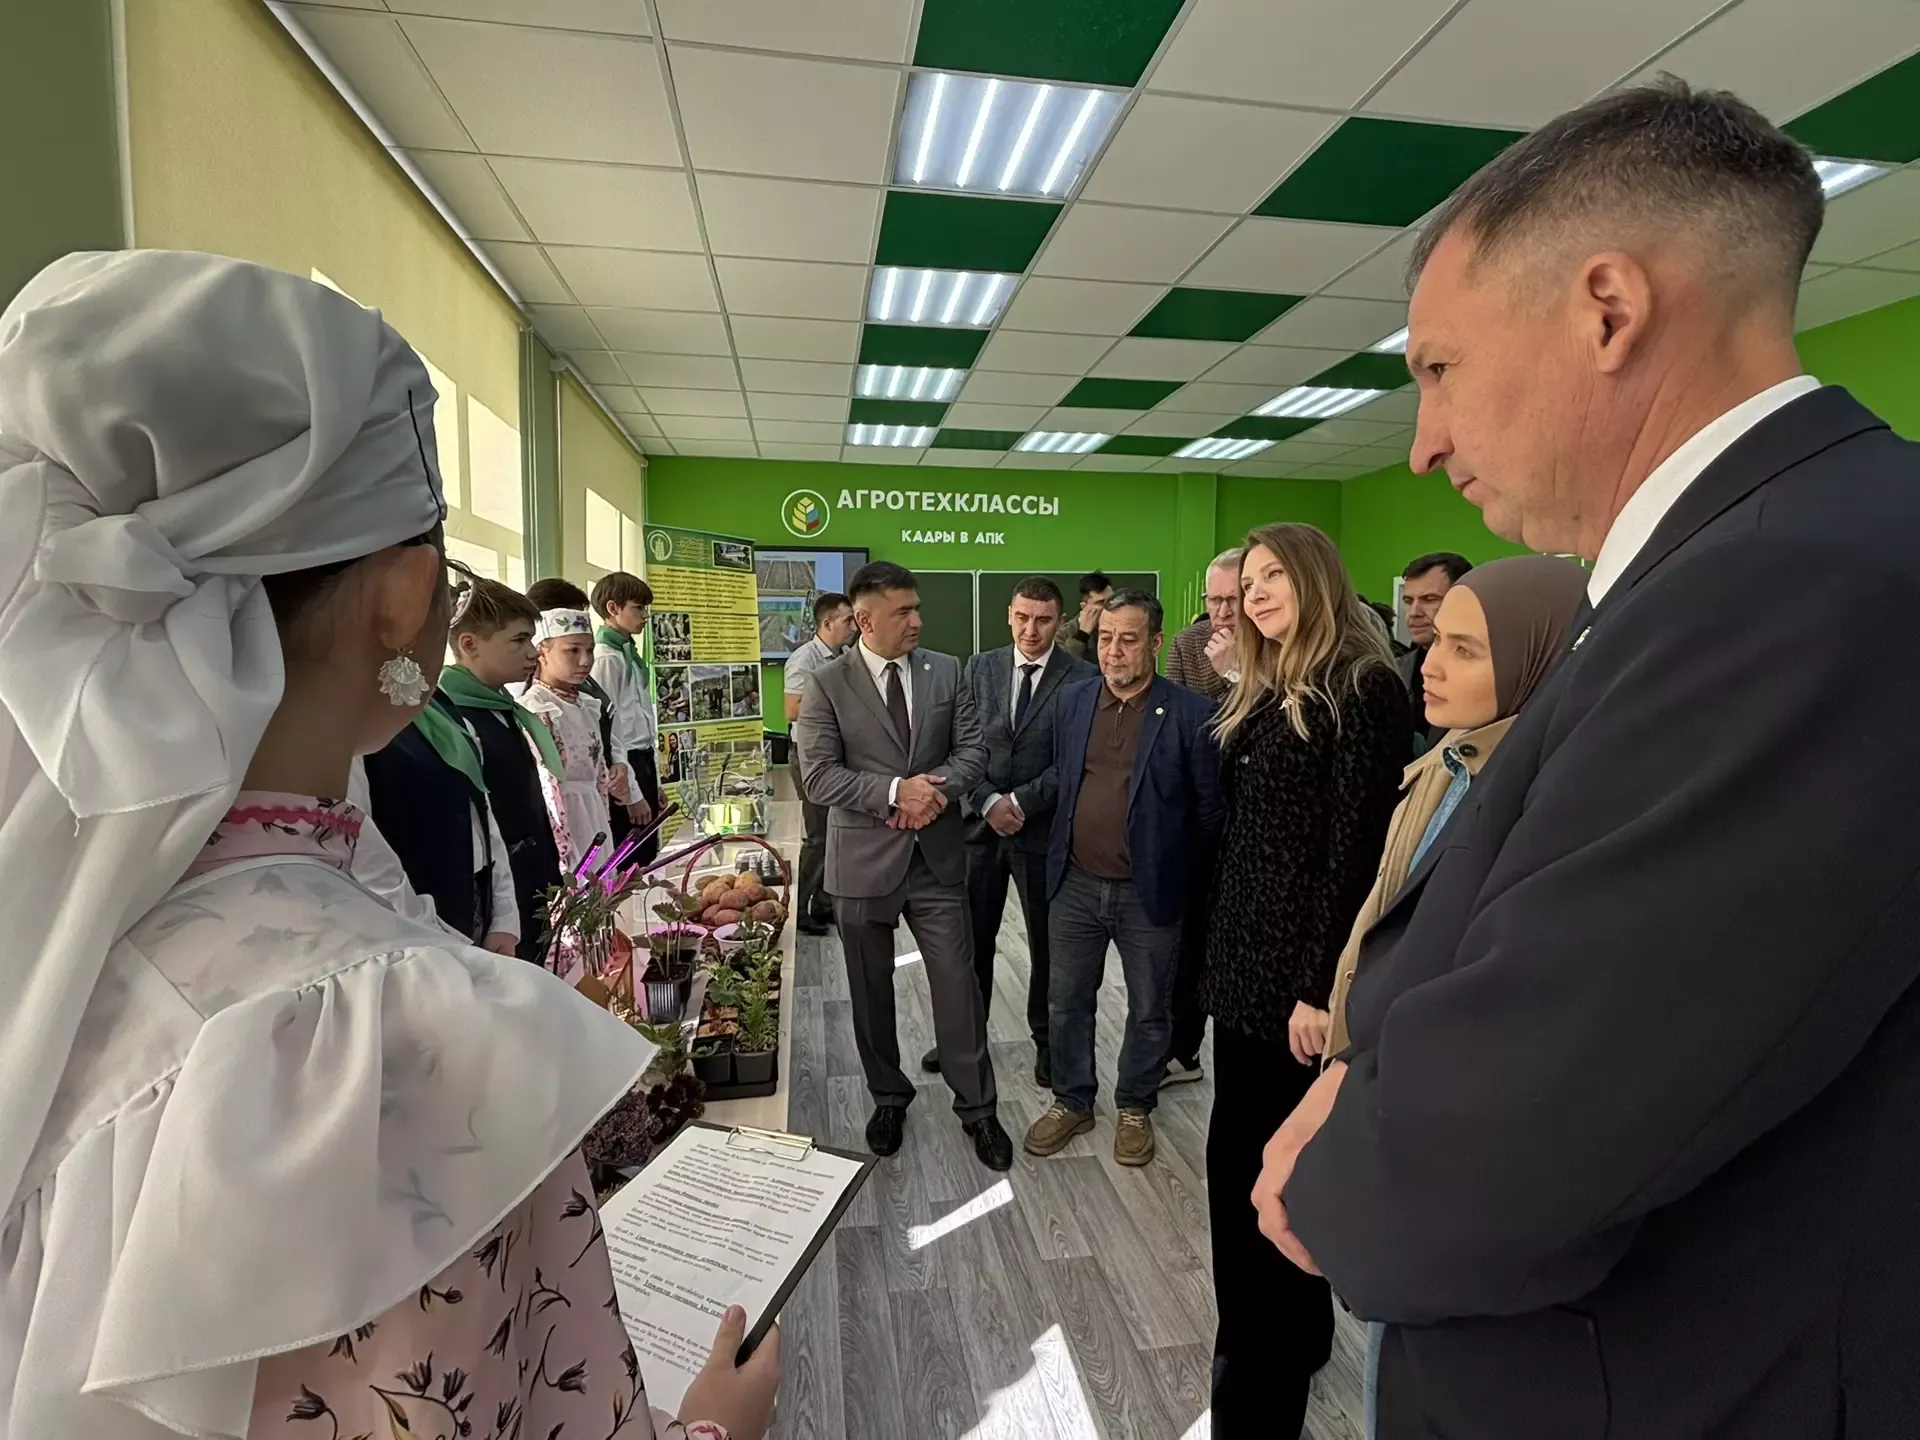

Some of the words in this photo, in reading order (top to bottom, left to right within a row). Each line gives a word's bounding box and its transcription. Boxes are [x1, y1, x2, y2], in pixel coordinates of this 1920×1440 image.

[836, 489, 1059, 515] АГРОТЕХКЛАССЫ
[901, 529, 955, 543] КАДРЫ
[959, 531, 968, 543] В
[974, 531, 1004, 544] АПК
